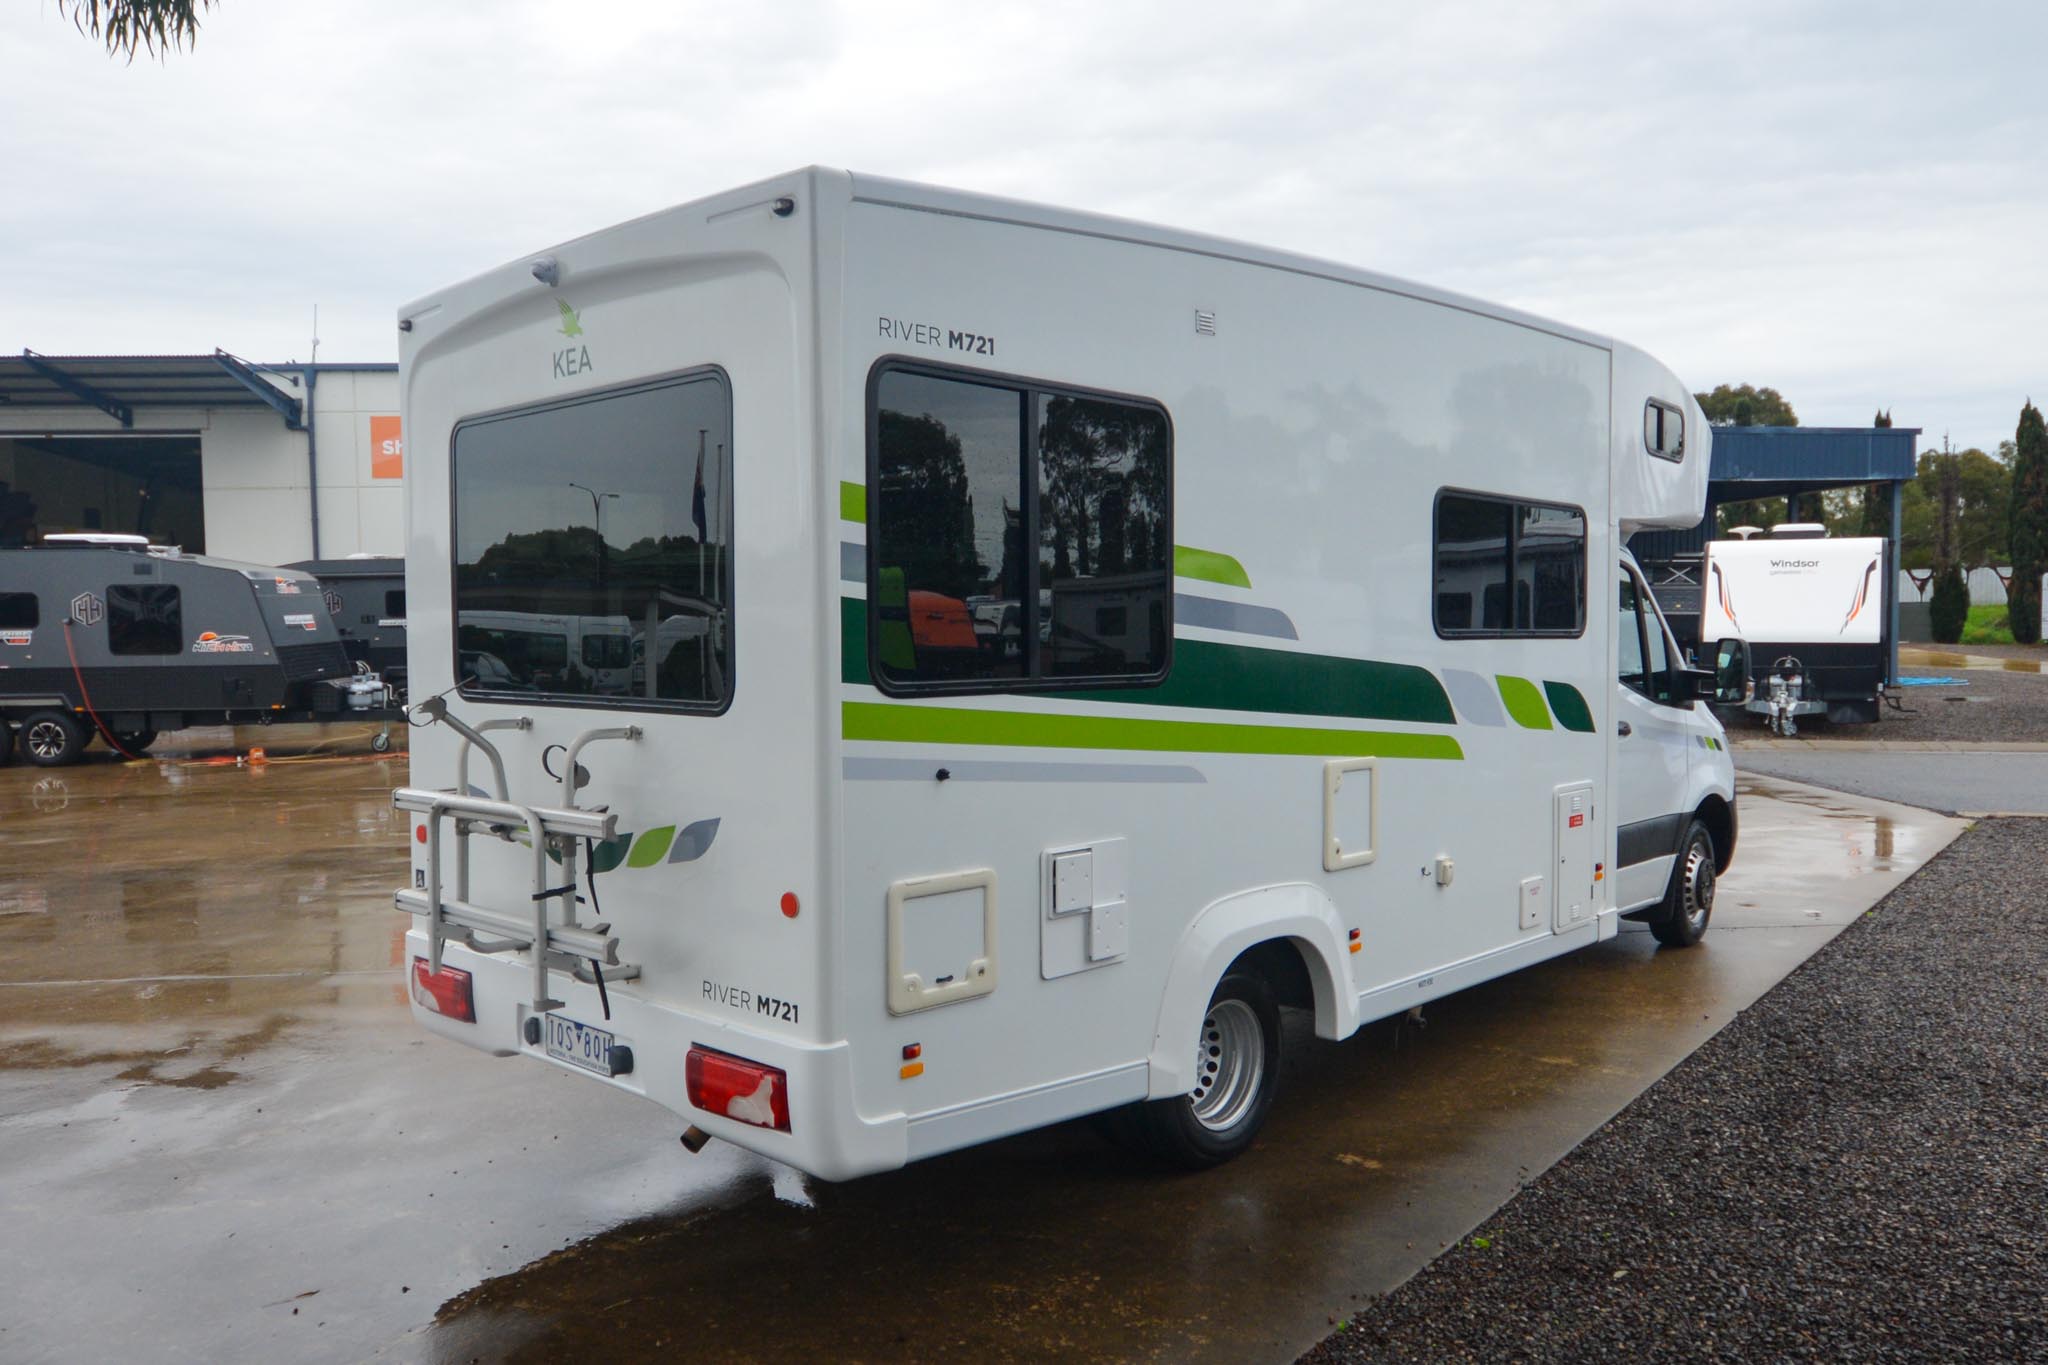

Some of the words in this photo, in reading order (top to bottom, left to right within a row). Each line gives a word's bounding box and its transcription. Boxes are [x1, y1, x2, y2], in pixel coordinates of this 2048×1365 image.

[879, 316, 941, 347] RIVER
[948, 329, 995, 356] M721
[553, 344, 592, 380] KEA
[1770, 559, 1820, 568] Windsor
[702, 980, 751, 1011] RIVER
[757, 994, 799, 1024] M721
